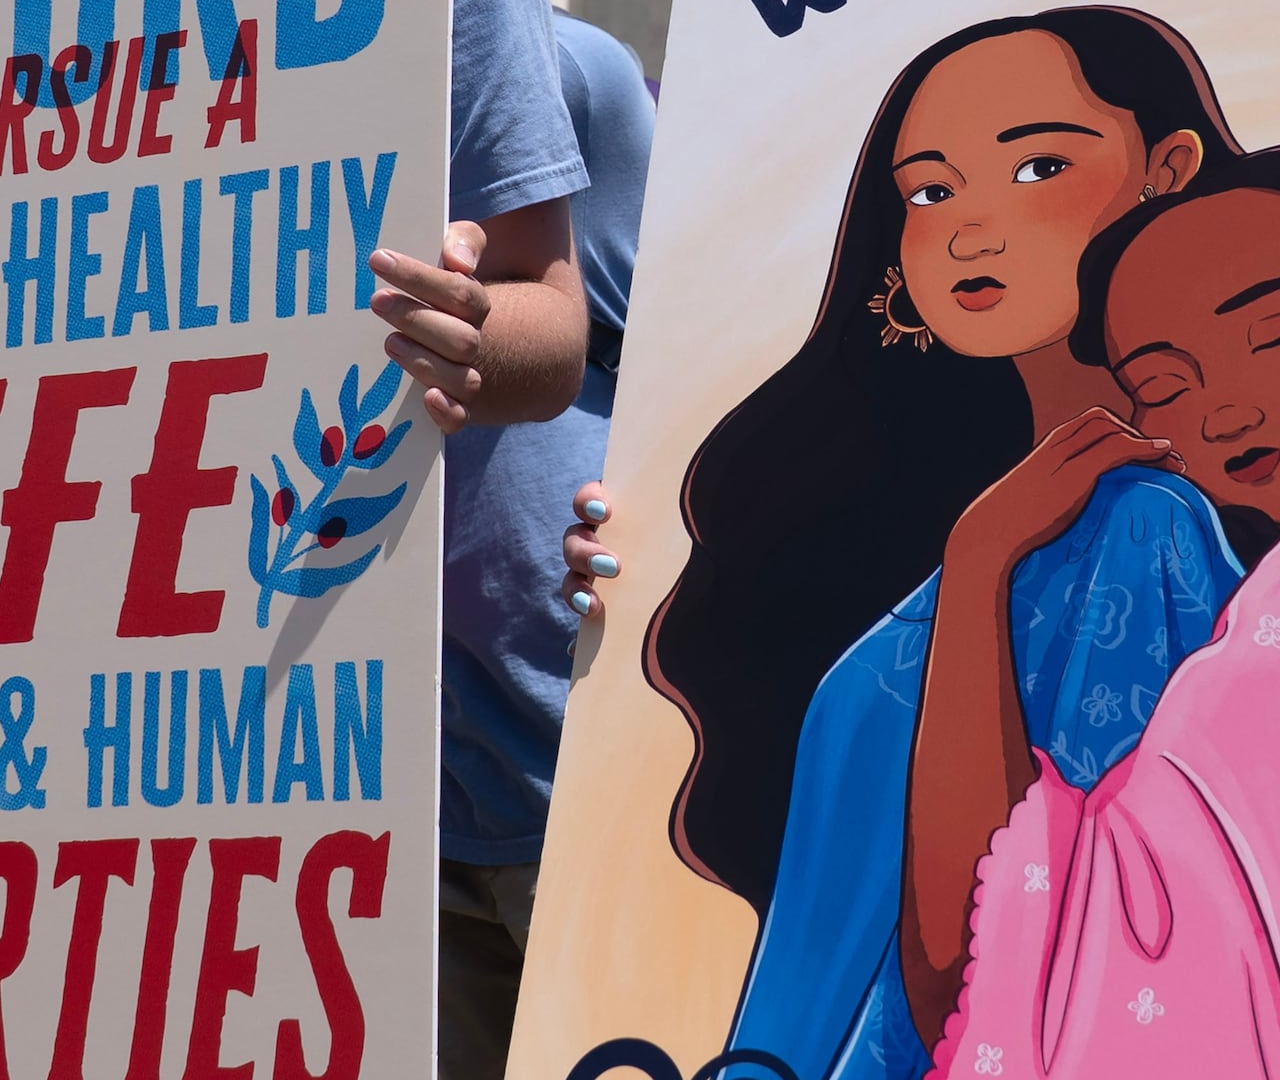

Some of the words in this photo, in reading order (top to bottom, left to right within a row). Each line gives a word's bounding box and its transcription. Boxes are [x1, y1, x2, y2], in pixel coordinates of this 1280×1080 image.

[203, 18, 258, 150] A
[2, 151, 399, 350] HEALTHY
[83, 659, 384, 809] HUMAN
